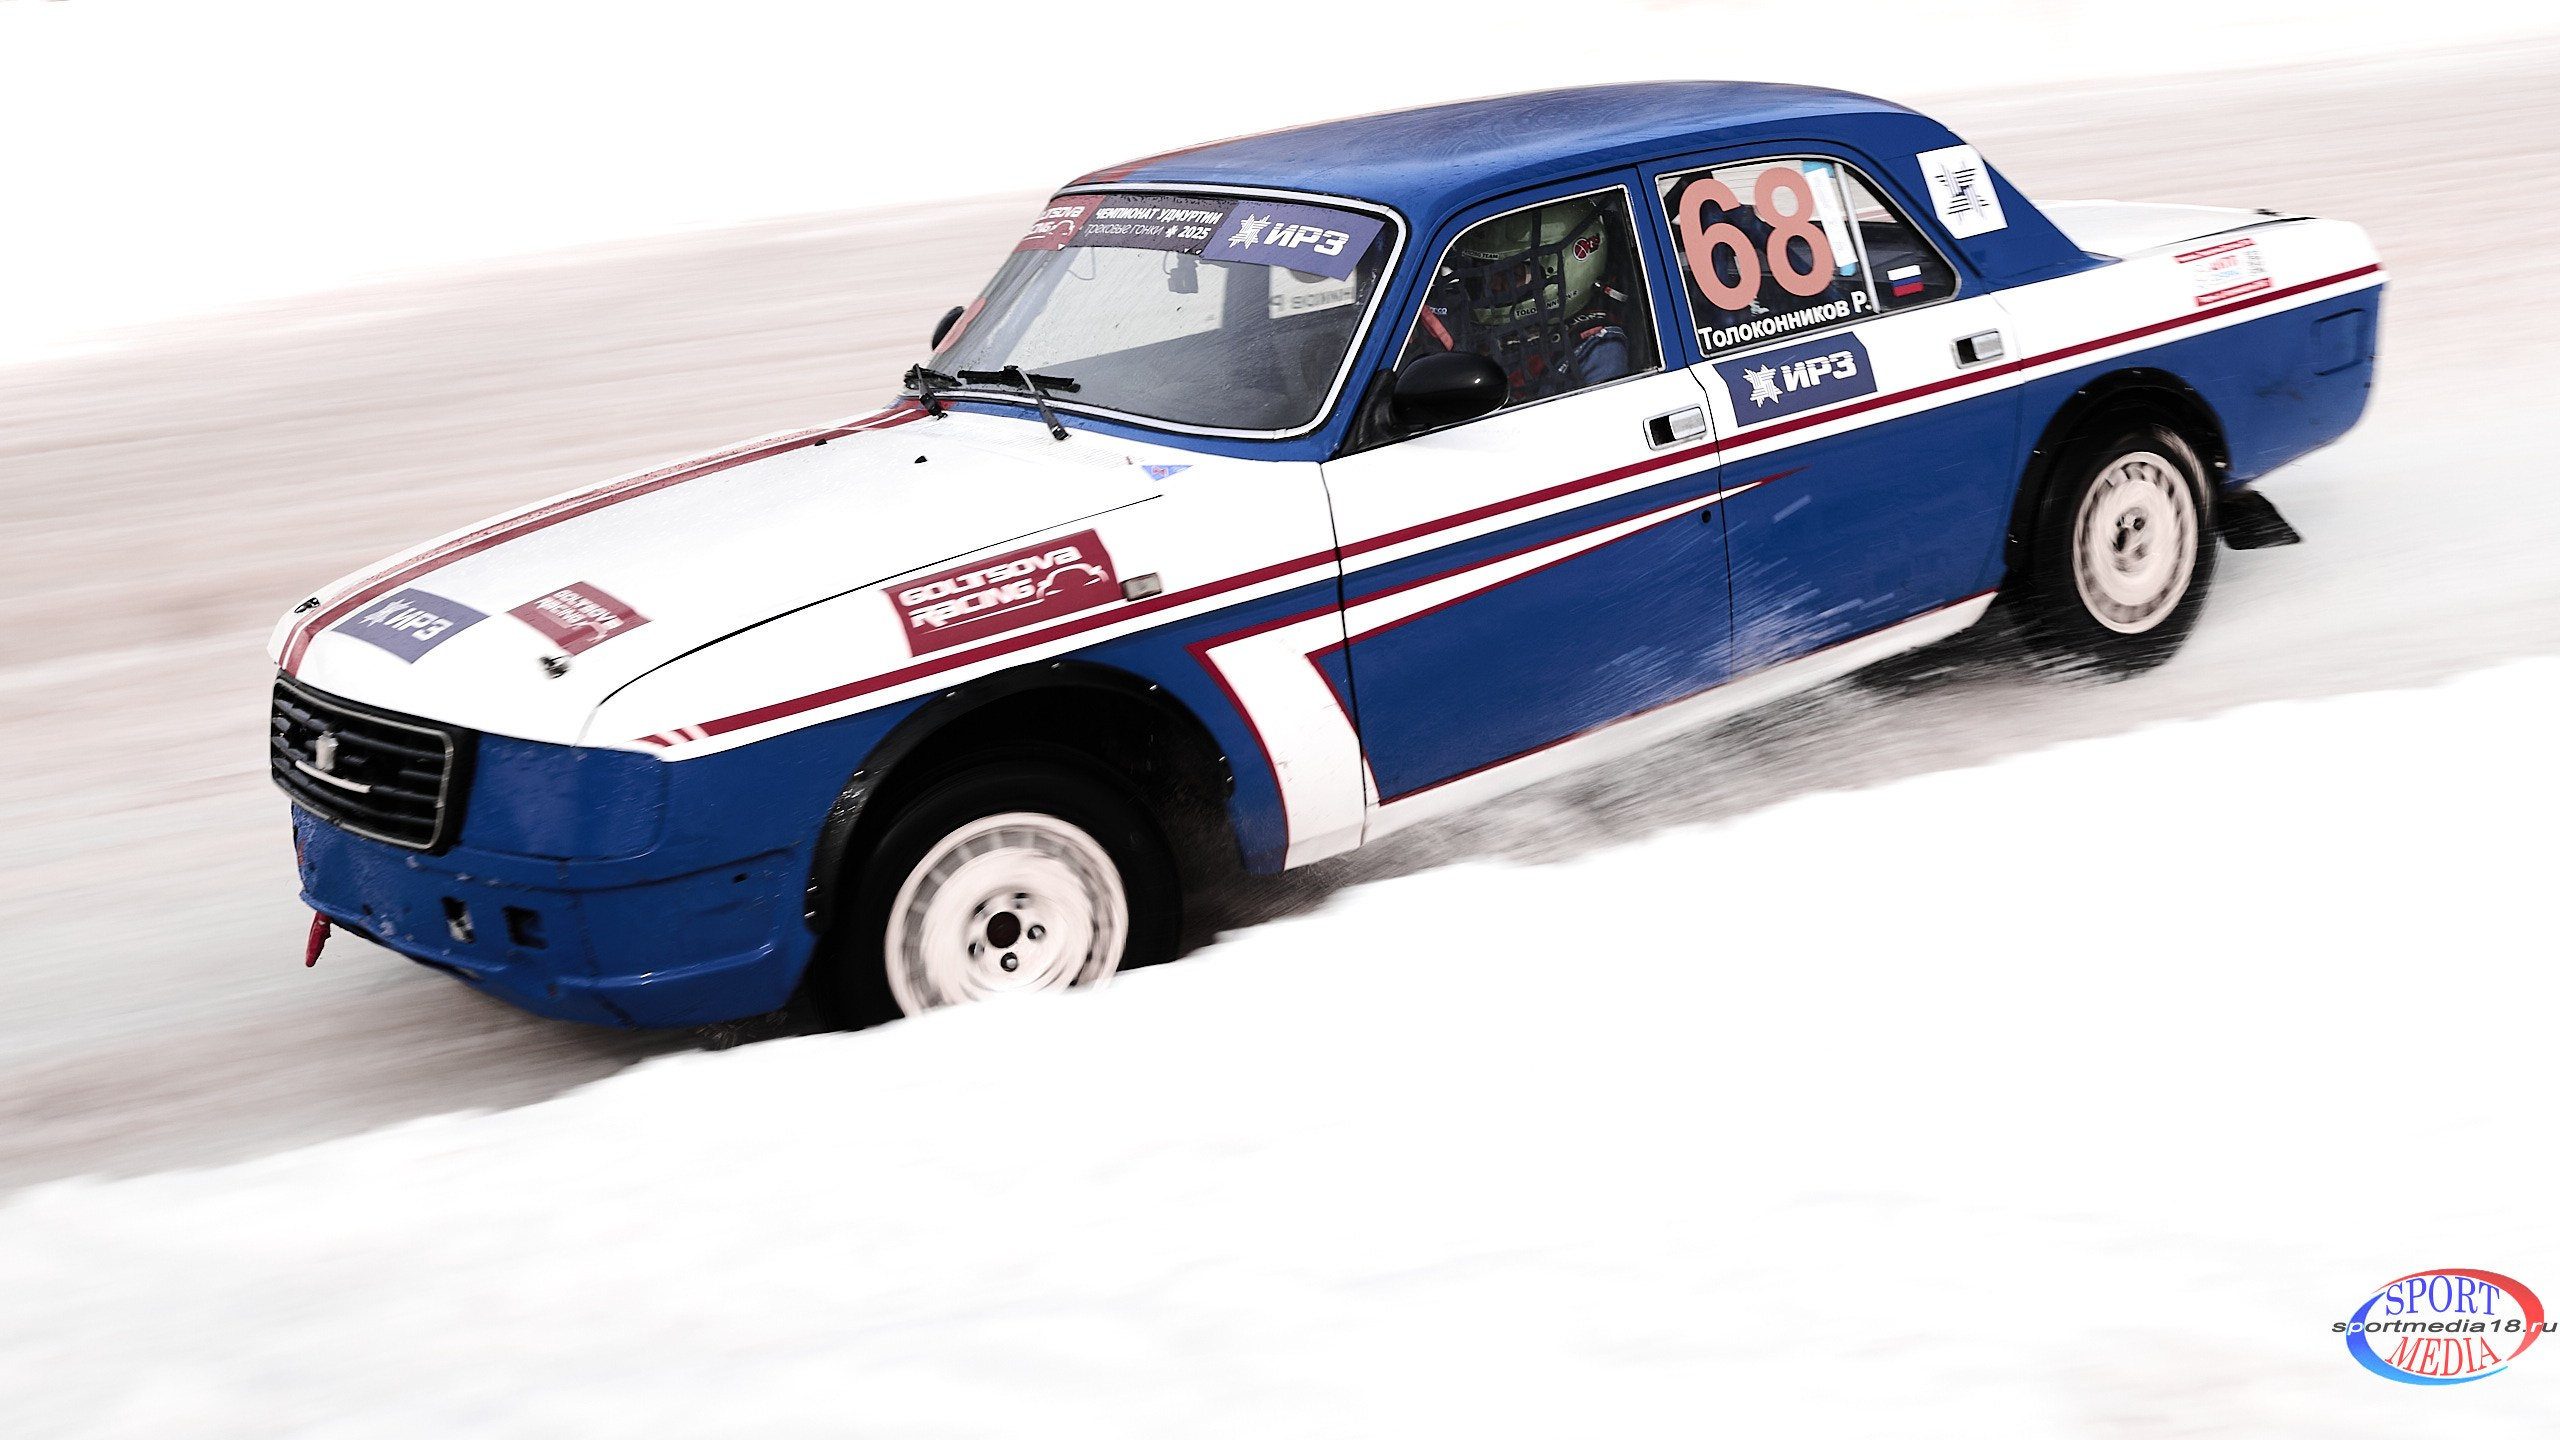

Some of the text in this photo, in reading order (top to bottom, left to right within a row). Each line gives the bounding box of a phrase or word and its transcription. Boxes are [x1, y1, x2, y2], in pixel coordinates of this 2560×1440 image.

[1096, 207, 1223, 225] ЧЕМПИОНАТ УДМУРТИИ
[1178, 225, 1212, 240] 2025
[1263, 222, 1350, 257] ИРЗ
[1679, 167, 1834, 311] 68
[1698, 290, 1873, 350] Толоконников Р.
[1780, 351, 1858, 392] ИРЗ
[384, 608, 455, 641] ИРЗ
